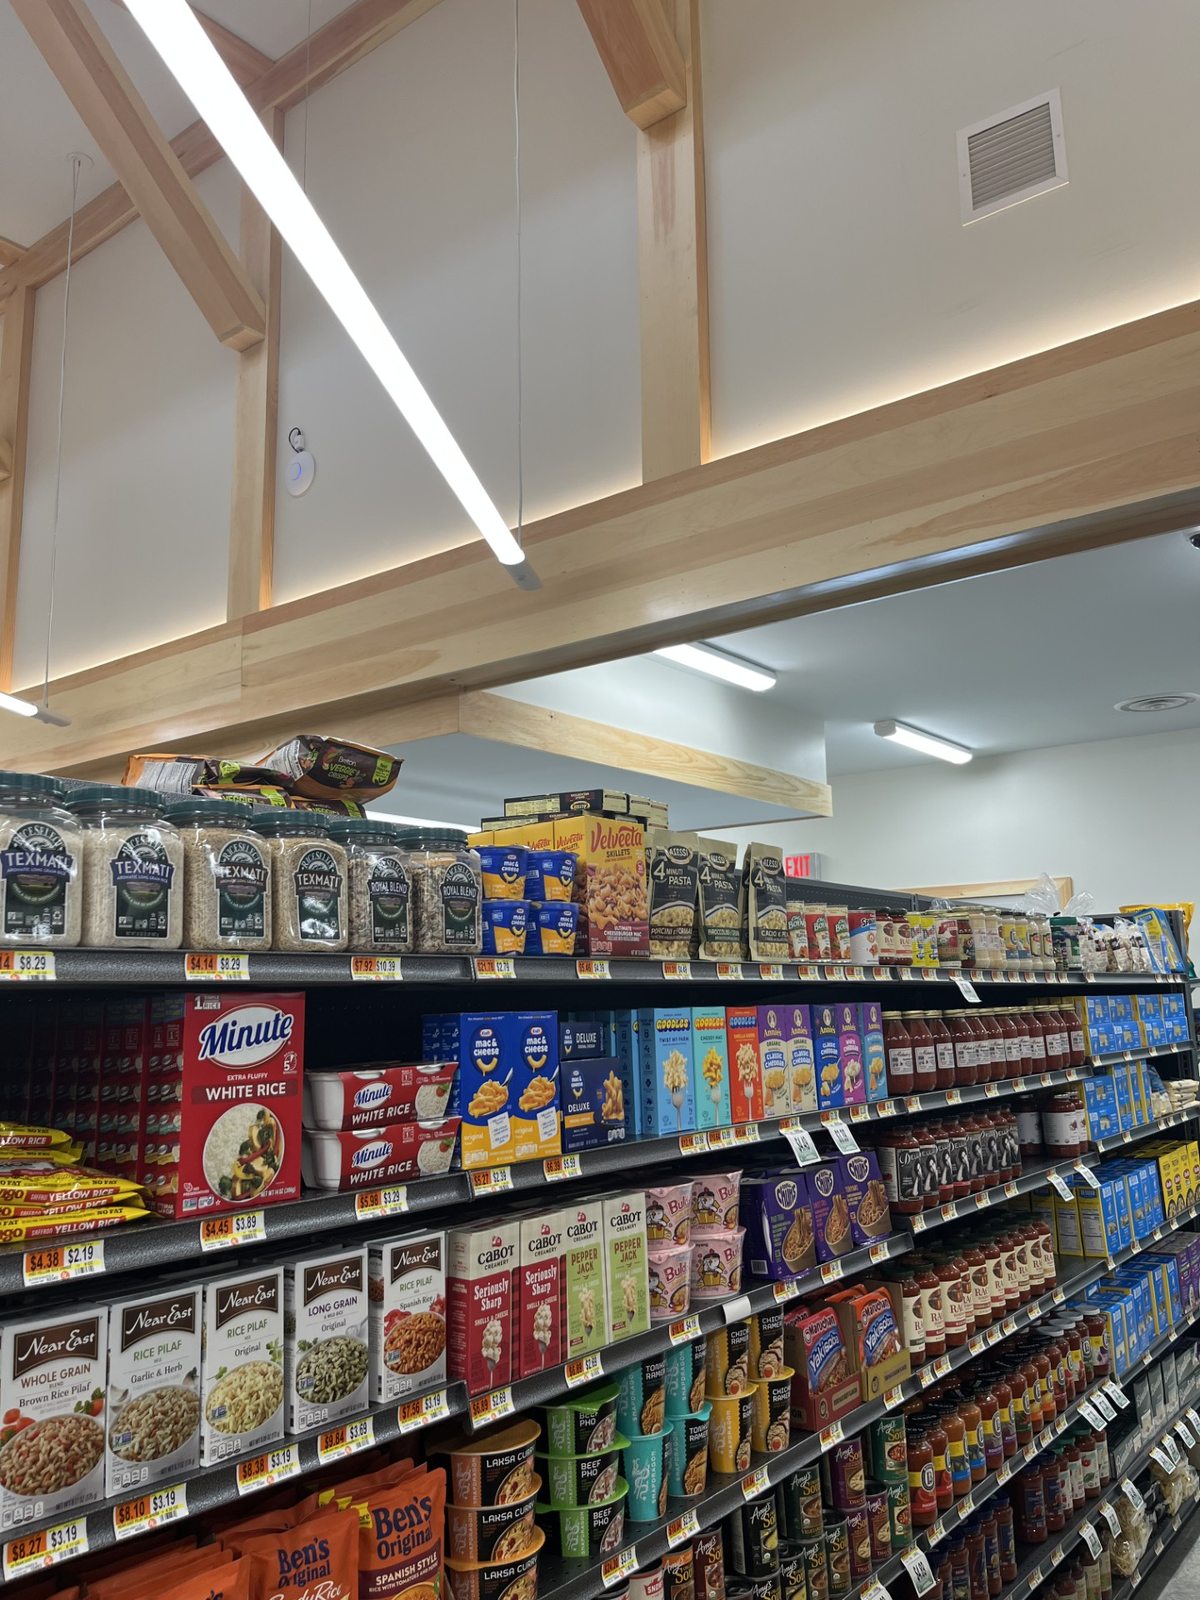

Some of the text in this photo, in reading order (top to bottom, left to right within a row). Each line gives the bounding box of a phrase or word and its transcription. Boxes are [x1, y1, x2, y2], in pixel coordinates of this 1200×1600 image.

[591, 822, 642, 852] Velveeta
[606, 848, 630, 858] SKILLETS
[668, 848, 689, 857] ALESSI
[115, 860, 170, 878] TEXMATI
[654, 861, 666, 880] 4
[786, 855, 811, 877] EXIT
[296, 873, 341, 888] TEXMATI
[668, 876, 692, 886] PASTA
[700, 866, 712, 884] 4
[754, 870, 764, 887] 4
[371, 882, 408, 894] ROYAL BLEND
[443, 886, 476, 898] ROYAL BLEND
[714, 882, 734, 890] PASTA
[766, 884, 782, 894] PASTA
[20, 956, 46, 970] $8.29
[190, 957, 240, 970] $4.14 $8.29
[354, 960, 396, 971] $7.92 $10.39
[496, 962, 510, 971] $2.79
[194, 996, 202, 1010] 1
[656, 1018, 690, 1032] GOODLES
[694, 1017, 725, 1030] GOODLES
[729, 1016, 756, 1028] GOODLES
[820, 1026, 836, 1034] Annie's
[198, 1010, 294, 1060] Minute
[576, 1033, 597, 1044] DELUXE
[284, 1060, 290, 1071] 5
[227, 1072, 268, 1082] EXTRA FLUFFY
[206, 1082, 286, 1101] WHITE RICE
[354, 1082, 392, 1106] Minute
[352, 1104, 411, 1126] WHITE RICE
[568, 1102, 590, 1112] DELUXE
[28, 1136, 47, 1145] RICE
[352, 1142, 393, 1166] Minute
[350, 1160, 412, 1184] WHITE RICE
[474, 1170, 506, 1186] $5.27 $2.39
[48, 1188, 115, 1202] YELLOW RICE
[358, 1190, 400, 1208] $5.98 $3.29
[54, 1222, 96, 1234] YELLOW
[205, 1216, 257, 1237] $4.45 $3.89
[616, 1224, 637, 1232] CREAMERY
[573, 1234, 594, 1243] CREAMERY
[614, 1237, 642, 1254] PEPPER
[30, 1246, 94, 1270] $4.38 $2.19
[394, 1246, 439, 1270] Near East
[534, 1247, 558, 1257] CREAMERY
[570, 1248, 598, 1266] PEPPER
[620, 1250, 638, 1264] JACK
[484, 1258, 510, 1271] CREAMERY
[576, 1261, 594, 1274] JACK
[307, 1266, 360, 1291] Near East
[526, 1264, 558, 1286] Seriously
[400, 1276, 432, 1292] RICE PILAF
[474, 1278, 509, 1300] Seriously
[532, 1282, 551, 1296] Sharp
[220, 1285, 276, 1314] Near East
[308, 1296, 358, 1316] LONG GRAIN
[400, 1296, 433, 1310] Spanish Rice
[481, 1297, 502, 1312] Sharp
[126, 1304, 193, 1334] Near East
[322, 1318, 346, 1332] Original
[474, 1310, 509, 1326] SHELLS CHEESE
[227, 1318, 268, 1339] RICE PILAF
[865, 1314, 895, 1352] Yakisoba
[18, 1329, 96, 1362] Near East
[133, 1340, 183, 1362] RICE PILAF
[234, 1342, 261, 1357] Original
[810, 1333, 840, 1372] Yakisoba
[20, 1363, 91, 1389] WHOLE GRAIN
[130, 1370, 155, 1384] Garlic
[164, 1362, 183, 1376] Herb
[19, 1382, 92, 1408] Brown Rice Pilaf
[402, 1402, 420, 1420] $7.56
[424, 1396, 441, 1412] $3.19
[580, 1418, 596, 1427] PHO
[877, 1420, 895, 1436] Amy's
[324, 1424, 368, 1450] $9.84 $3.69
[242, 1449, 291, 1478] $8.38 $3.19
[486, 1454, 516, 1468] LAKSA
[580, 1459, 601, 1470] BEEF
[581, 1468, 598, 1478] PHO
[792, 1472, 812, 1490] Amy's
[118, 1490, 176, 1524] $8.10 $3.19
[593, 1507, 612, 1520] BEEF
[750, 1502, 771, 1524] Amy's
[372, 1495, 432, 1540] Ben's
[482, 1509, 512, 1524] LAKSA
[593, 1517, 610, 1528] PHO
[12, 1525, 78, 1561] $8.27 $3.19
[376, 1523, 433, 1560] Original
[696, 1536, 716, 1559] Amy's
[277, 1537, 330, 1576] Ben's
[376, 1552, 438, 1586] SPANISH STYLE
[484, 1566, 514, 1580] LAKSA
[664, 1556, 685, 1574] Amy's
[277, 1562, 331, 1590] Original
[382, 1582, 394, 1590] WITH
[395, 1574, 420, 1586] TOMATOES
[420, 1569, 428, 1577] AND
